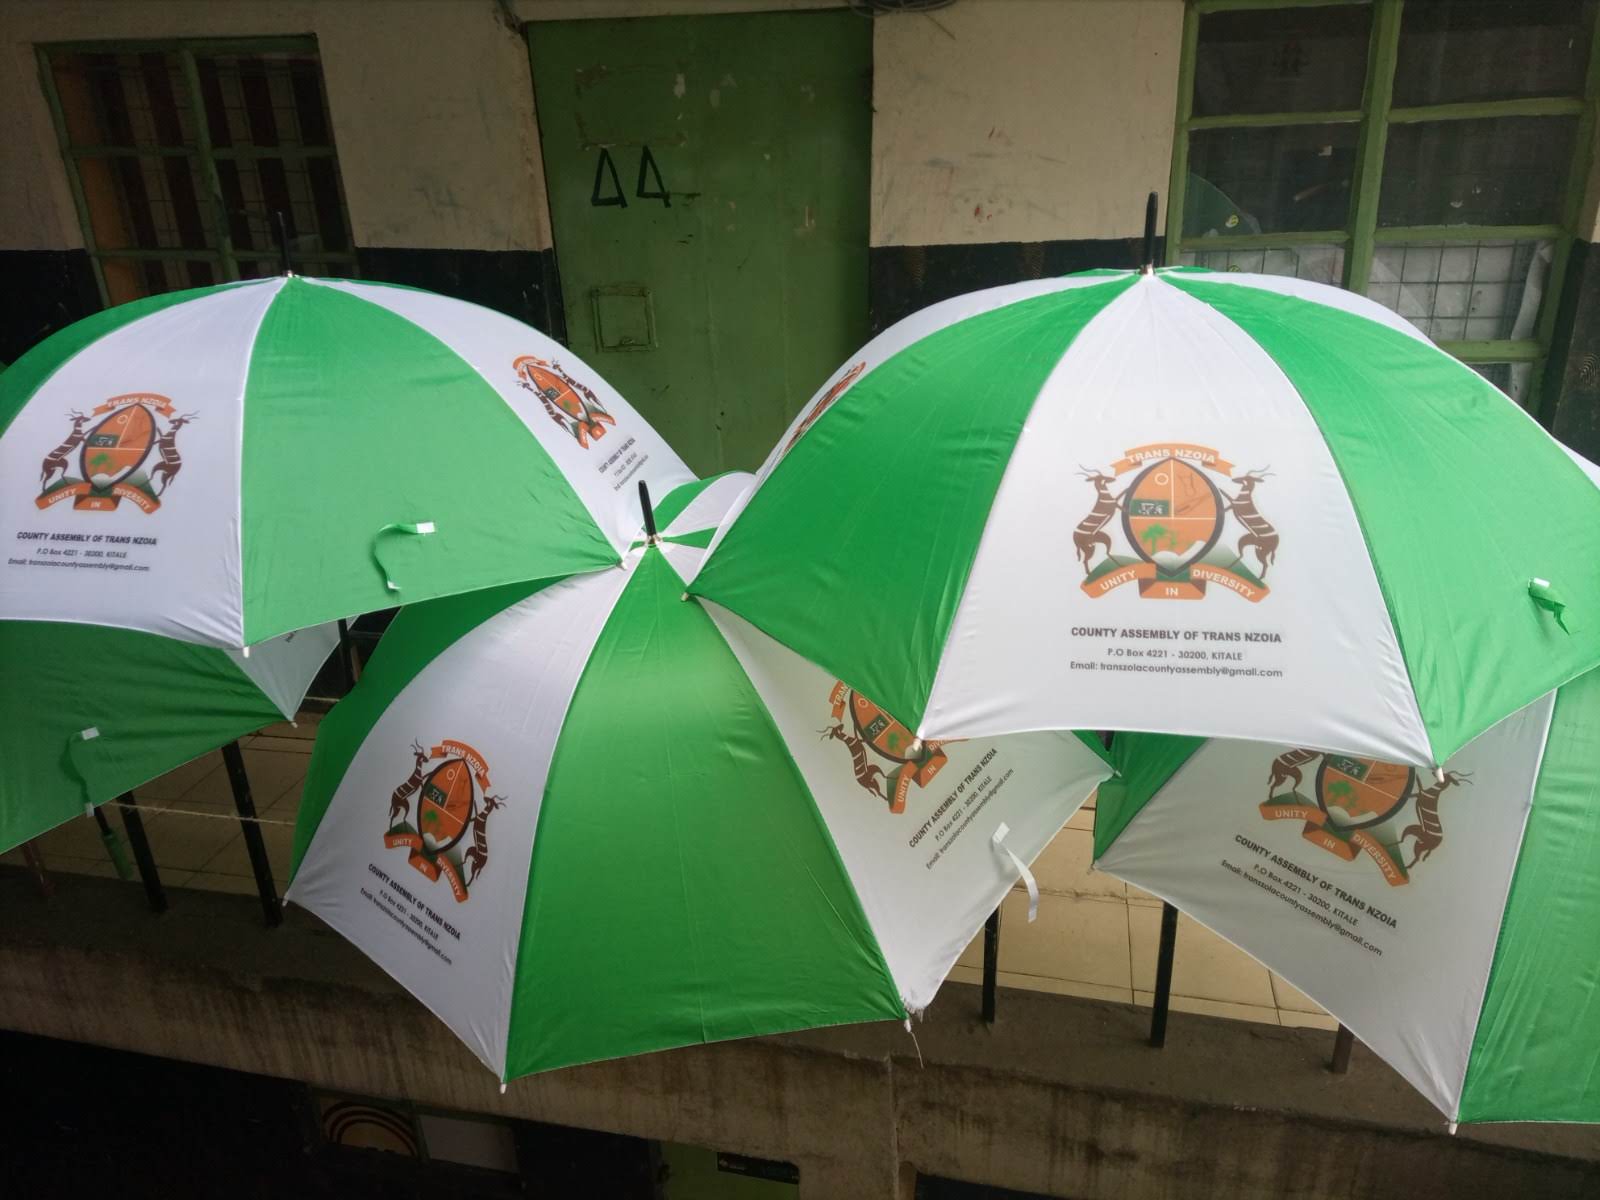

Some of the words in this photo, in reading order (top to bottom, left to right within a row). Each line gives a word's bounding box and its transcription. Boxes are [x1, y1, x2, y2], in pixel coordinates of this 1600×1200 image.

[107, 397, 139, 408] TRANS
[1127, 448, 1170, 463] TRANS
[1175, 448, 1215, 463] NZOIA
[48, 487, 77, 504] UNITY
[113, 487, 151, 510] DIVERSITY
[17, 532, 49, 540] COUNTY
[50, 533, 89, 542] ASSEMBLY
[106, 536, 130, 544] TRANS
[133, 537, 157, 545] NZOIA
[1100, 570, 1136, 591] UNITY
[1165, 587, 1179, 596] IN
[1193, 569, 1255, 597] DIVERSITY
[1071, 627, 1117, 638] COUNTY
[1120, 629, 1180, 641] ASSEMBLY
[1183, 630, 1199, 640] OF
[1202, 631, 1241, 641] TRANS
[1244, 632, 1282, 643] NZOIA
[1070, 661, 1098, 670] Email:
[1107, 648, 1124, 656] P.O
[1126, 648, 1144, 657] Box
[1146, 649, 1168, 658] 4221
[1211, 652, 1243, 661] KITALE
[834, 686, 849, 705] TRAN
[441, 745, 466, 757] TRANS
[466, 753, 485, 778] NZOIA
[898, 774, 909, 802] UNITY
[927, 765, 936, 776] IN
[909, 820, 932, 848] COUNTY
[931, 791, 958, 823] ASSEMBLY
[957, 783, 966, 793] OF
[964, 765, 982, 785] TRANS
[980, 748, 997, 768] NZOIA
[393, 838, 412, 846] UNITY
[1275, 810, 1308, 818] UNITY
[1323, 838, 1335, 849] IN
[1353, 834, 1396, 880] DIVERSITY
[1235, 835, 1271, 857] COUNTY
[1271, 854, 1319, 883] ASSEMBLY
[1319, 880, 1333, 891] OF
[1335, 888, 1366, 910] TRANS
[1367, 906, 1397, 928] NZOIA
[368, 863, 390, 883] COUNTY
[389, 880, 417, 904] ASSEMBLY
[417, 901, 425, 911] OF
[425, 907, 443, 926] TRANS
[443, 921, 460, 941] NZOIA
[1254, 864, 1267, 875] P.O
[1268, 871, 1282, 884] Box
[1284, 878, 1301, 894] 4221
[1333, 908, 1358, 926] KITALE
